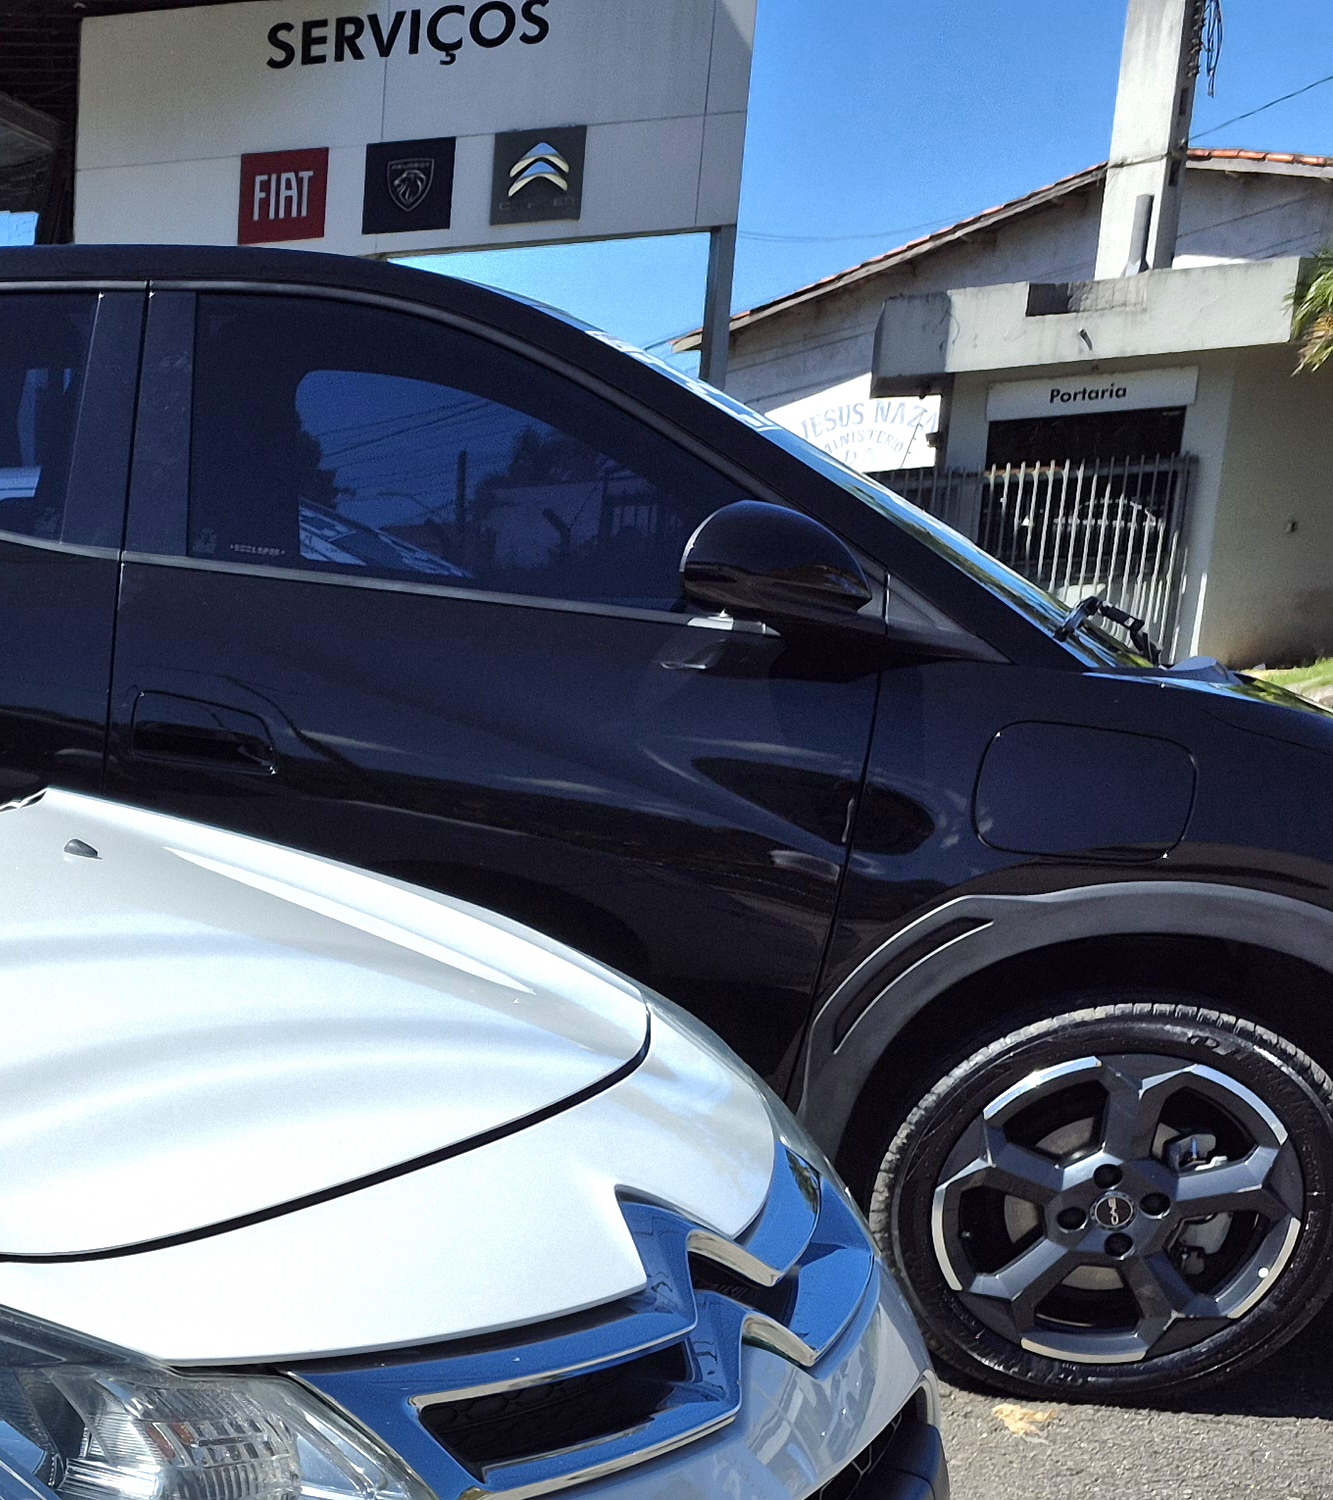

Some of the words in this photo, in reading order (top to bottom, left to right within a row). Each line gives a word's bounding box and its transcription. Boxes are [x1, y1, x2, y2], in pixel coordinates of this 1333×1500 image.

[266, 0, 549, 69] SERVIÇOS
[253, 170, 315, 222] FIAT
[1049, 382, 1127, 404] Portaria
[800, 402, 865, 440] JESUS
